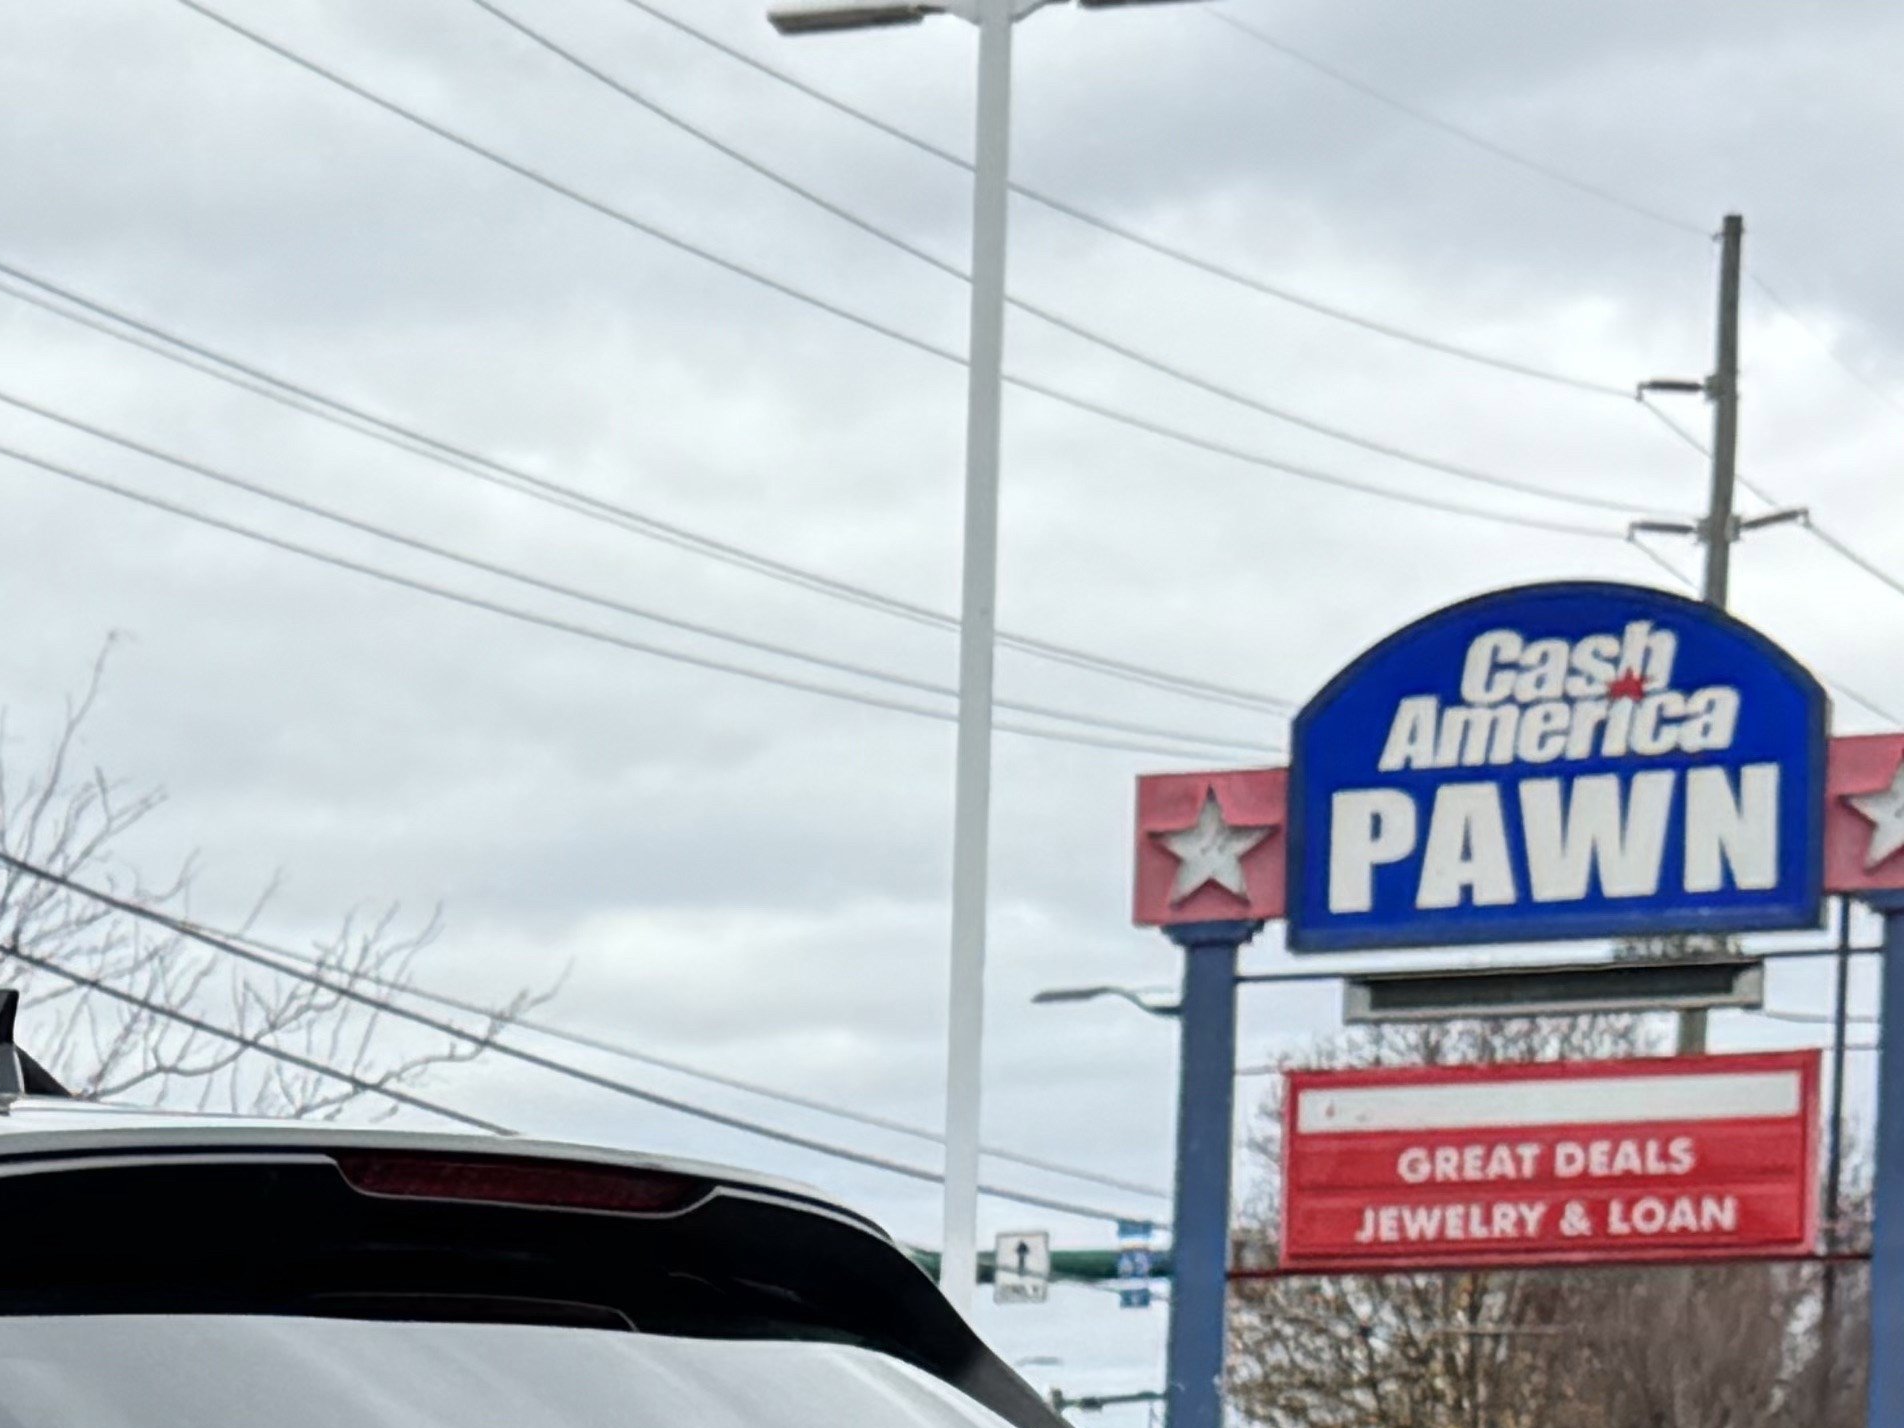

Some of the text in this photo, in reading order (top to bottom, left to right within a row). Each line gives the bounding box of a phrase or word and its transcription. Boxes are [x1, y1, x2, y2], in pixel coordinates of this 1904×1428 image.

[1460, 620, 1678, 704] Cash
[1378, 686, 1741, 772] America
[1329, 763, 1779, 914] PAWN
[1397, 1136, 1696, 1184] GREAT DEALS
[1354, 1195, 1739, 1244] JEWELRY & LOAN
